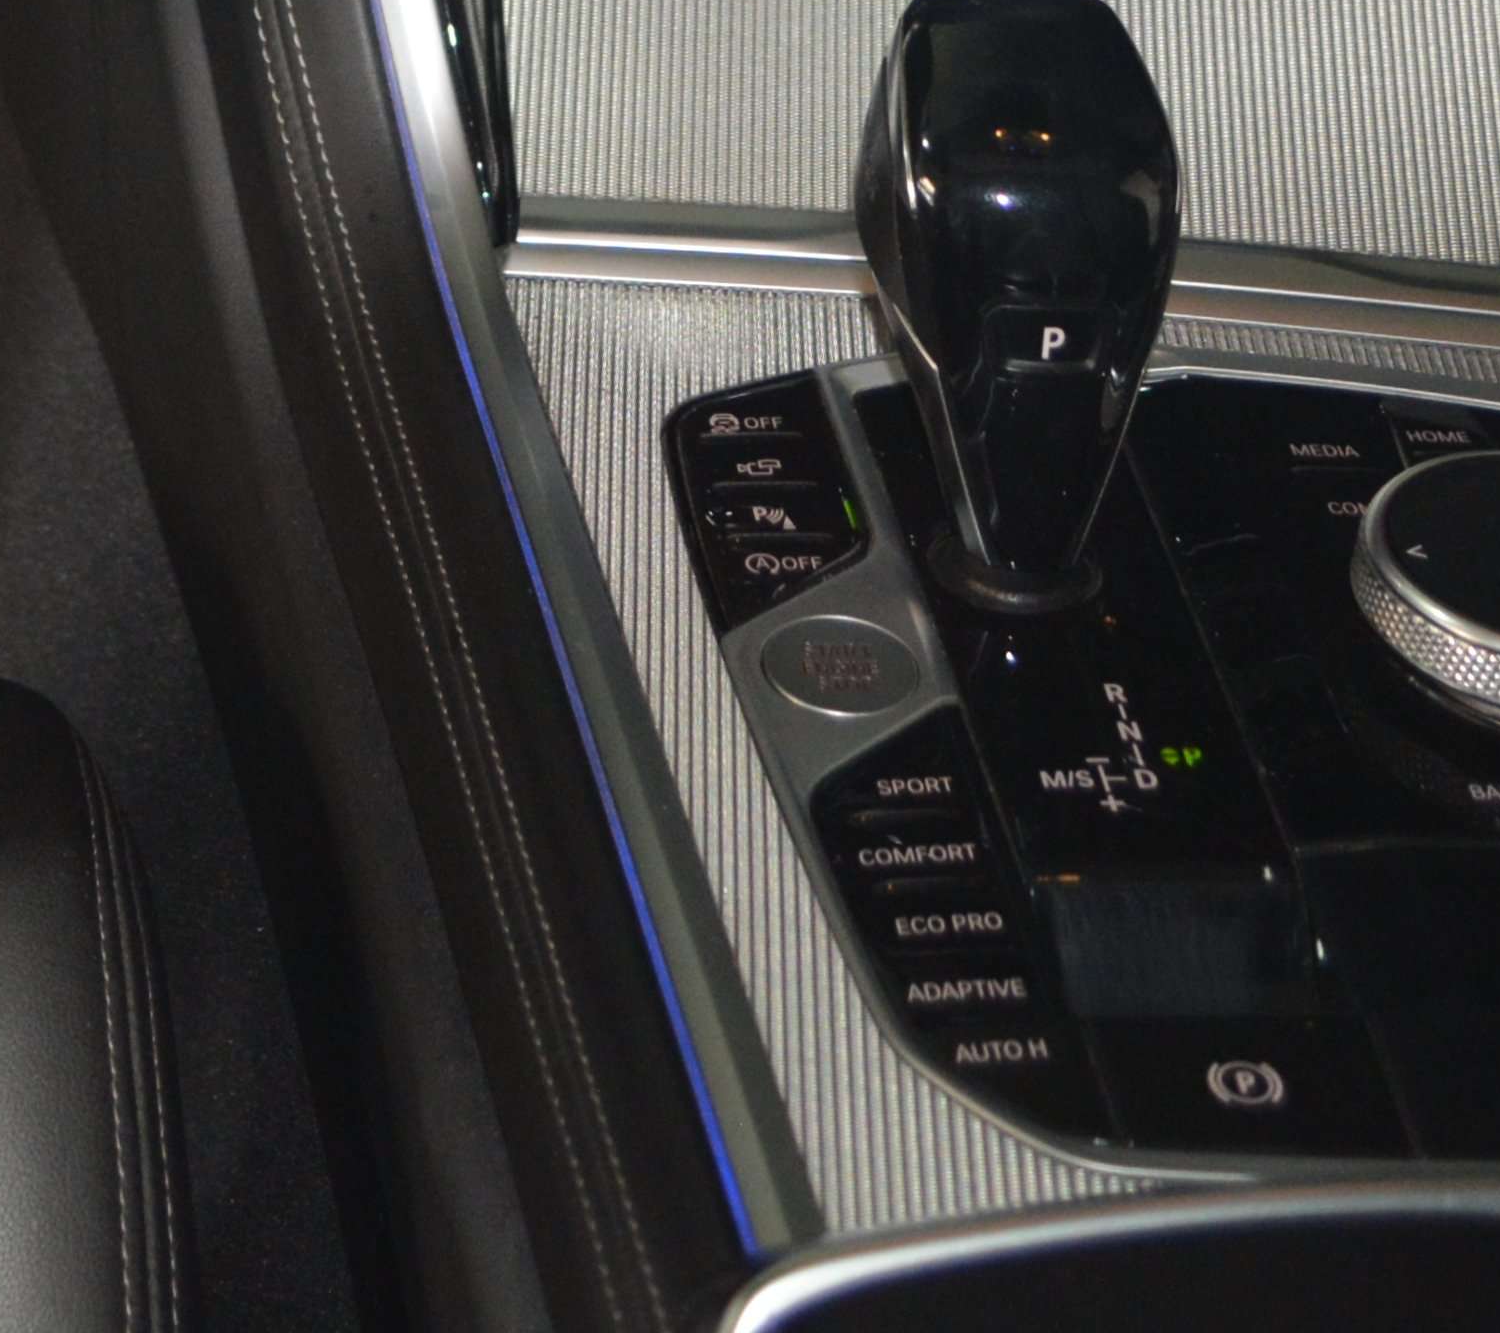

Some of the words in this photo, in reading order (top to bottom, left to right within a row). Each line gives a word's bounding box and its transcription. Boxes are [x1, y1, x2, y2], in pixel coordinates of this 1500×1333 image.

[1041, 327, 1065, 359] P
[744, 416, 783, 430] OFF
[1405, 430, 1471, 445] HOME
[1290, 443, 1360, 458] MEDIA
[781, 555, 823, 570] OFF
[1103, 683, 1128, 703] R
[1116, 721, 1143, 742] N
[877, 776, 952, 796] SPORT
[1039, 769, 1095, 789] M/S
[1133, 768, 1159, 789] D
[858, 843, 976, 866] COMFORT
[894, 914, 945, 936] ECO
[951, 911, 1003, 932] PRO
[907, 977, 1027, 1003] ADAPTIVE
[956, 1041, 1022, 1064] AUTO
[1028, 1038, 1048, 1059] H
